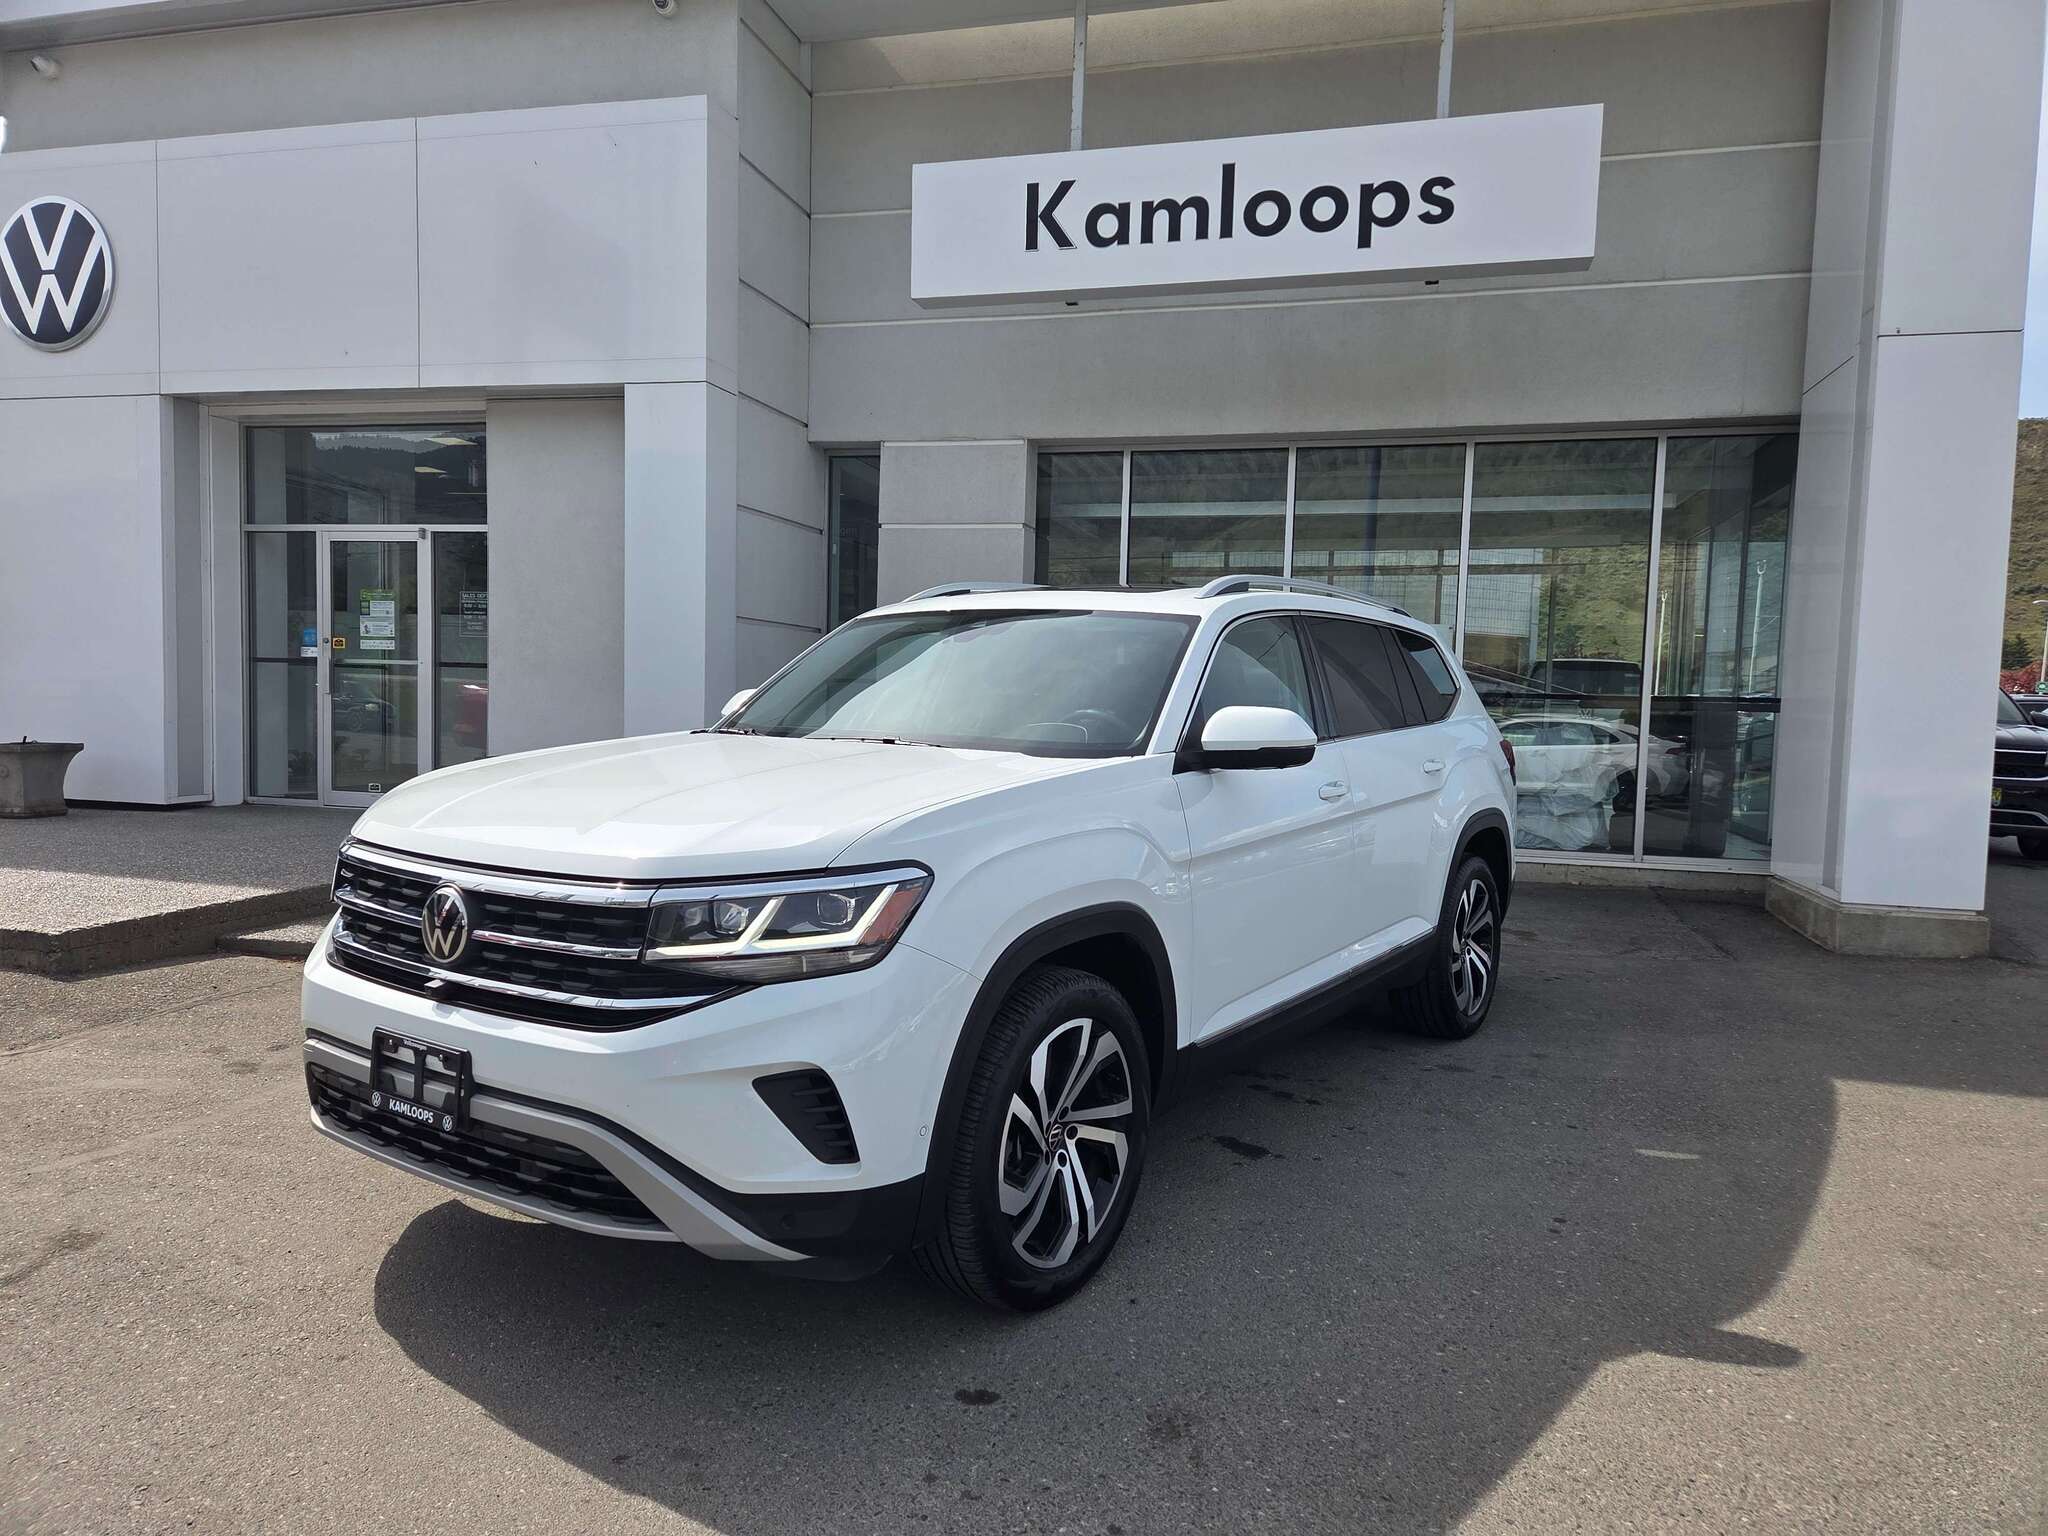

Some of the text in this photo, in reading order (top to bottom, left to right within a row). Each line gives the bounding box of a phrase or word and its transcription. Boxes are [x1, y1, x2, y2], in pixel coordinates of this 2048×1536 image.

[1025, 162, 1456, 251] Kamloops
[0, 200, 108, 340] VW
[423, 890, 465, 958] VW
[389, 1098, 434, 1124] KAMLOOPS
